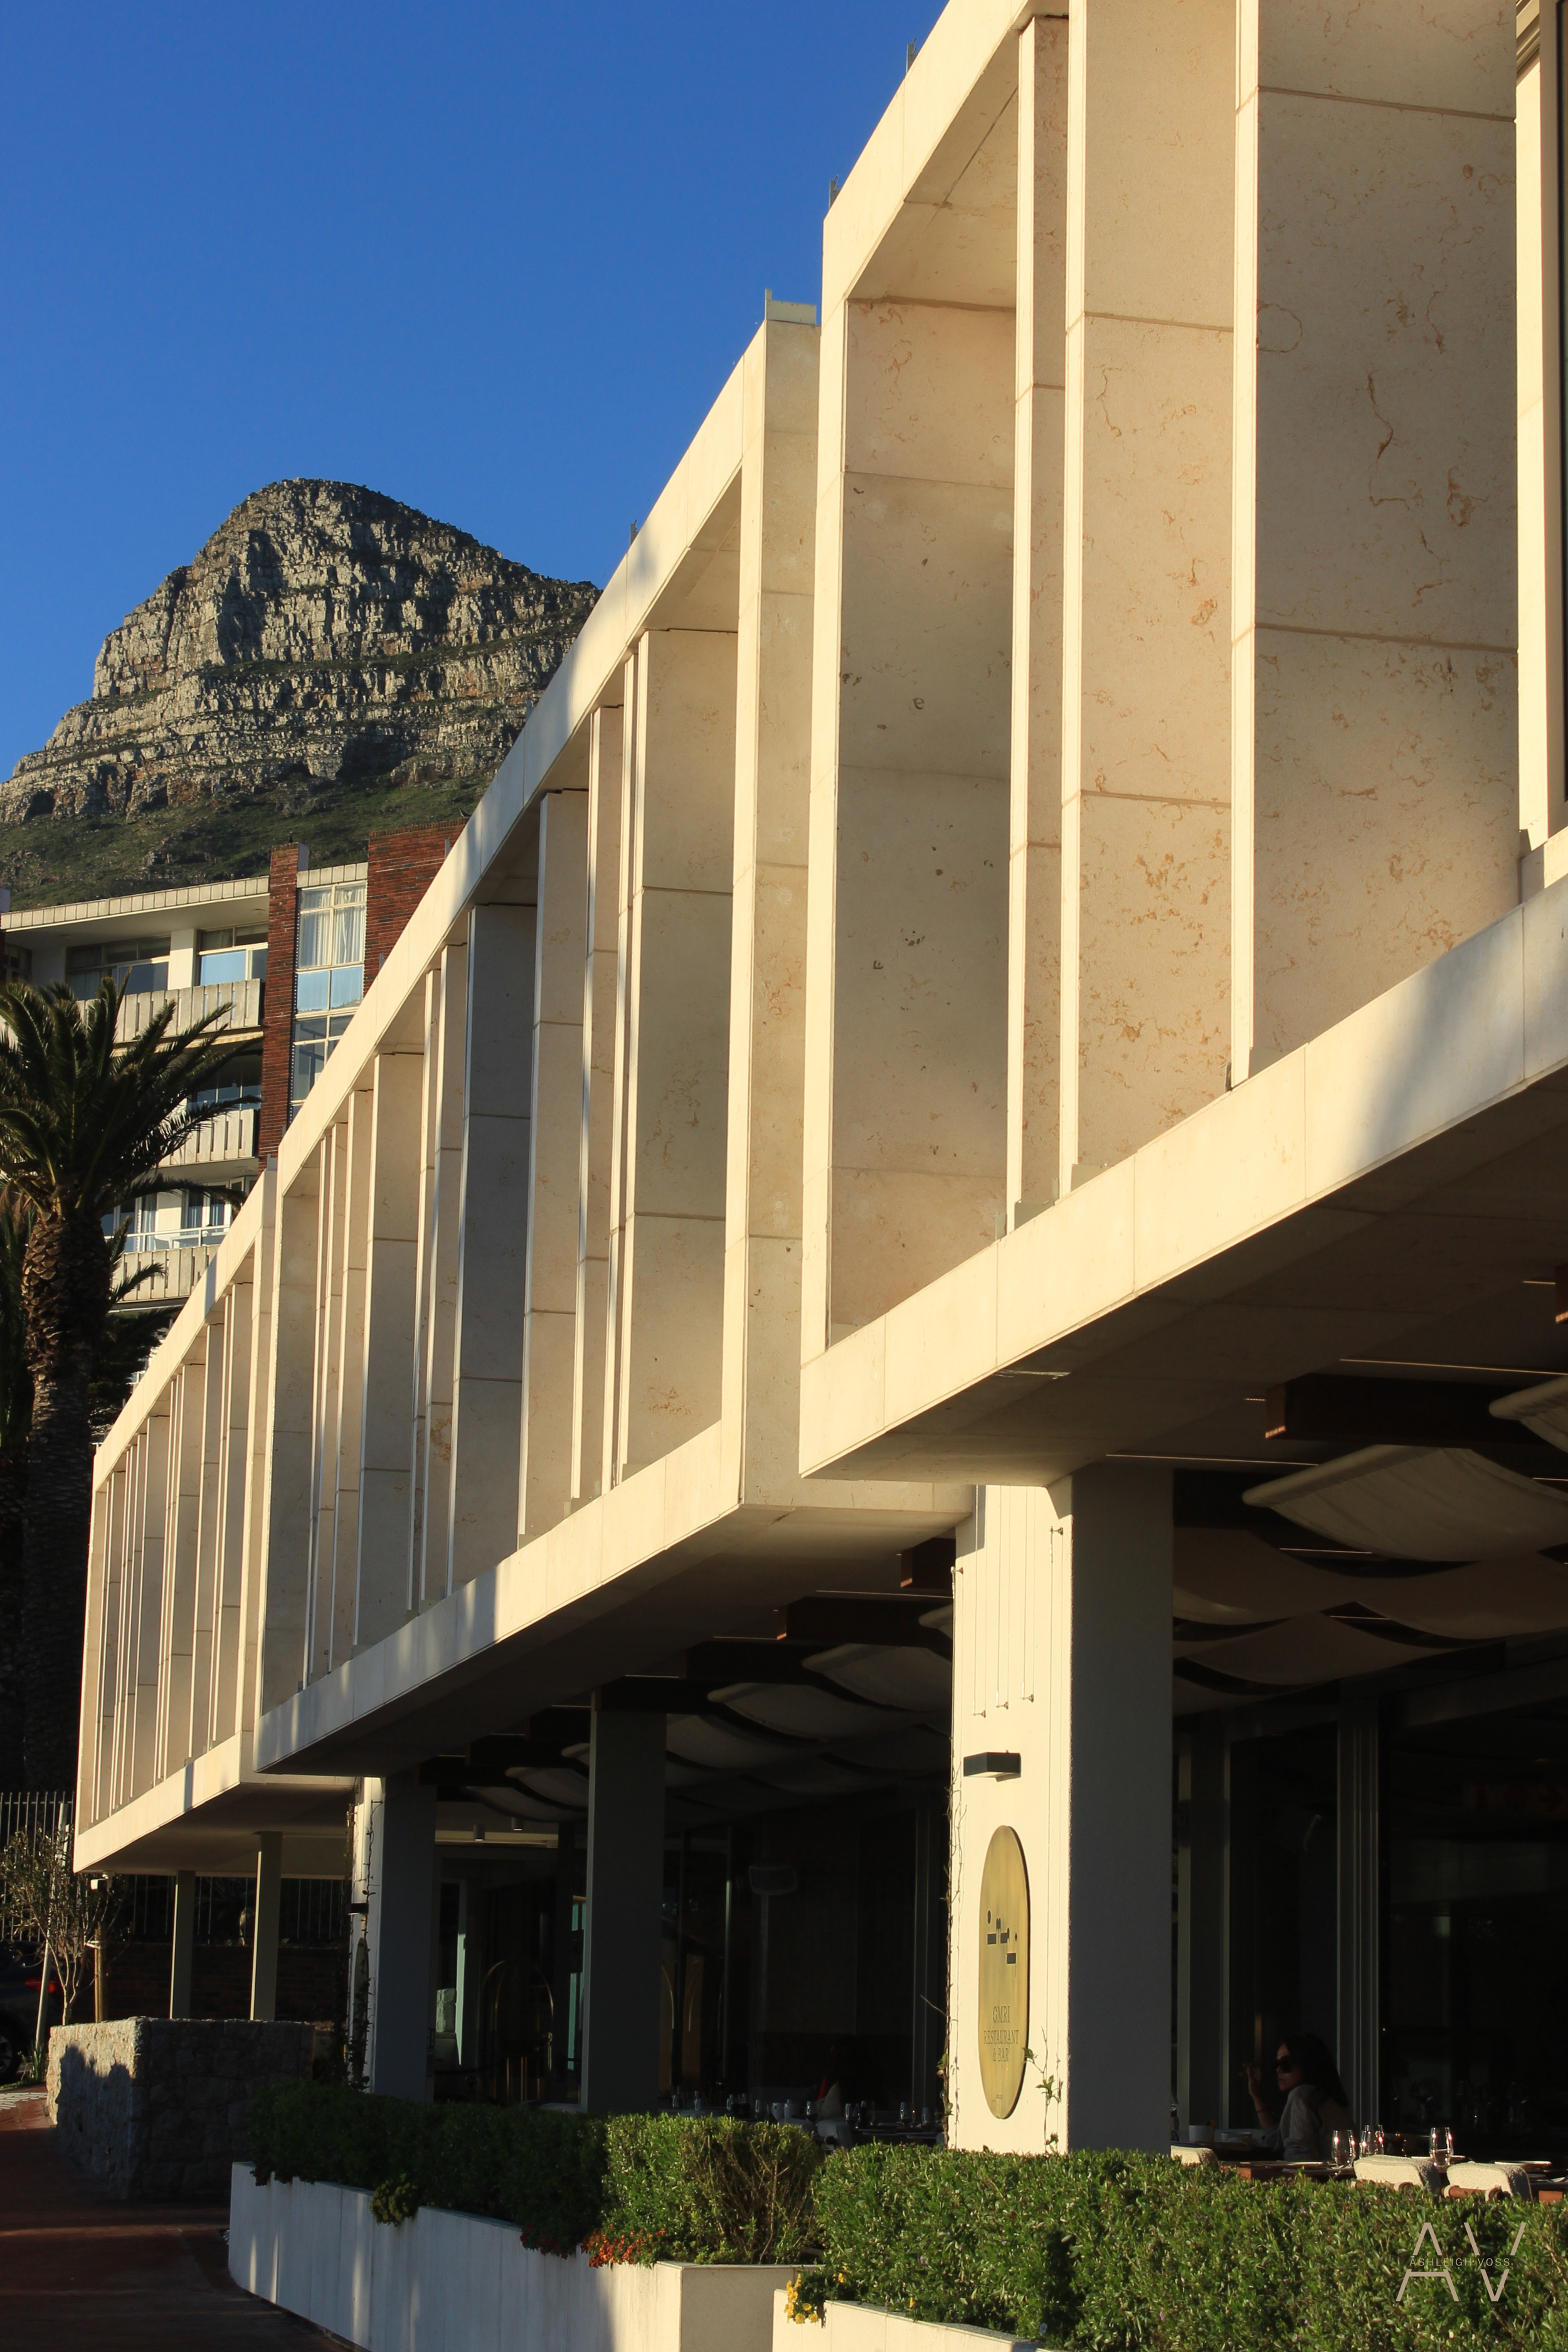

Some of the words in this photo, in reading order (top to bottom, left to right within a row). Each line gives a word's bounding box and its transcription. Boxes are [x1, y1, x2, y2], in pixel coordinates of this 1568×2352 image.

[993, 2005, 1010, 2023] OMRI
[983, 2030, 1019, 2044] RESTAURANT
[993, 2047, 997, 2062] &
[998, 2047, 1009, 2062] BAR
